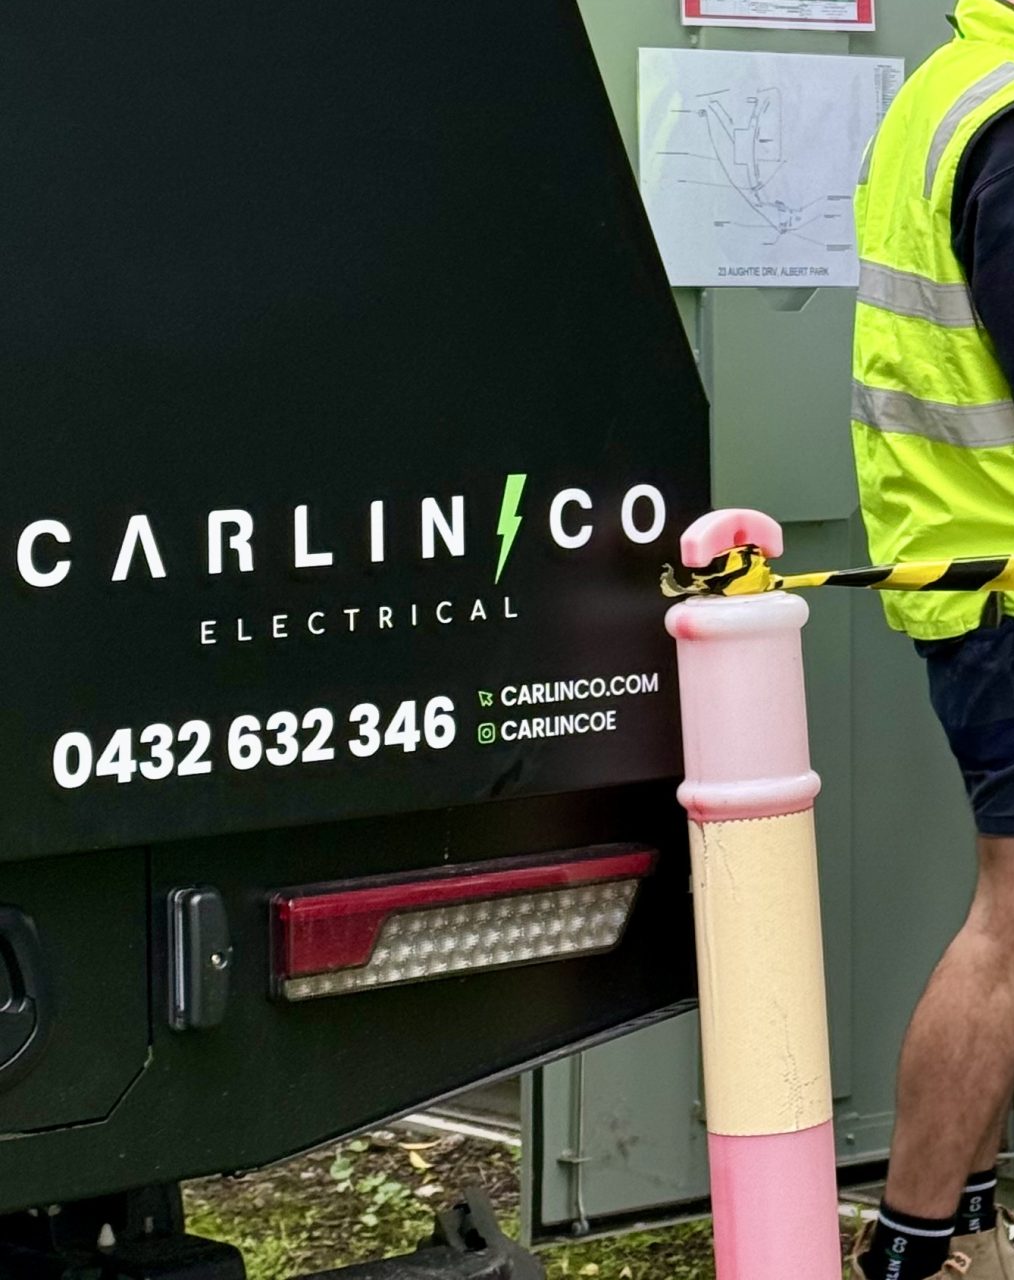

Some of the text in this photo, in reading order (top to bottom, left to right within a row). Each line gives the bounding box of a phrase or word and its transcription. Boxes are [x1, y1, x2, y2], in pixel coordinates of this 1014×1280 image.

[780, 266, 808, 277] ALBERT
[809, 266, 830, 277] PARK
[200, 596, 518, 645] ELECTRICAL
[500, 672, 659, 707] CARLINCO.COM
[52, 695, 457, 789] 0432 632 346
[500, 709, 617, 743] CARLINCOE
